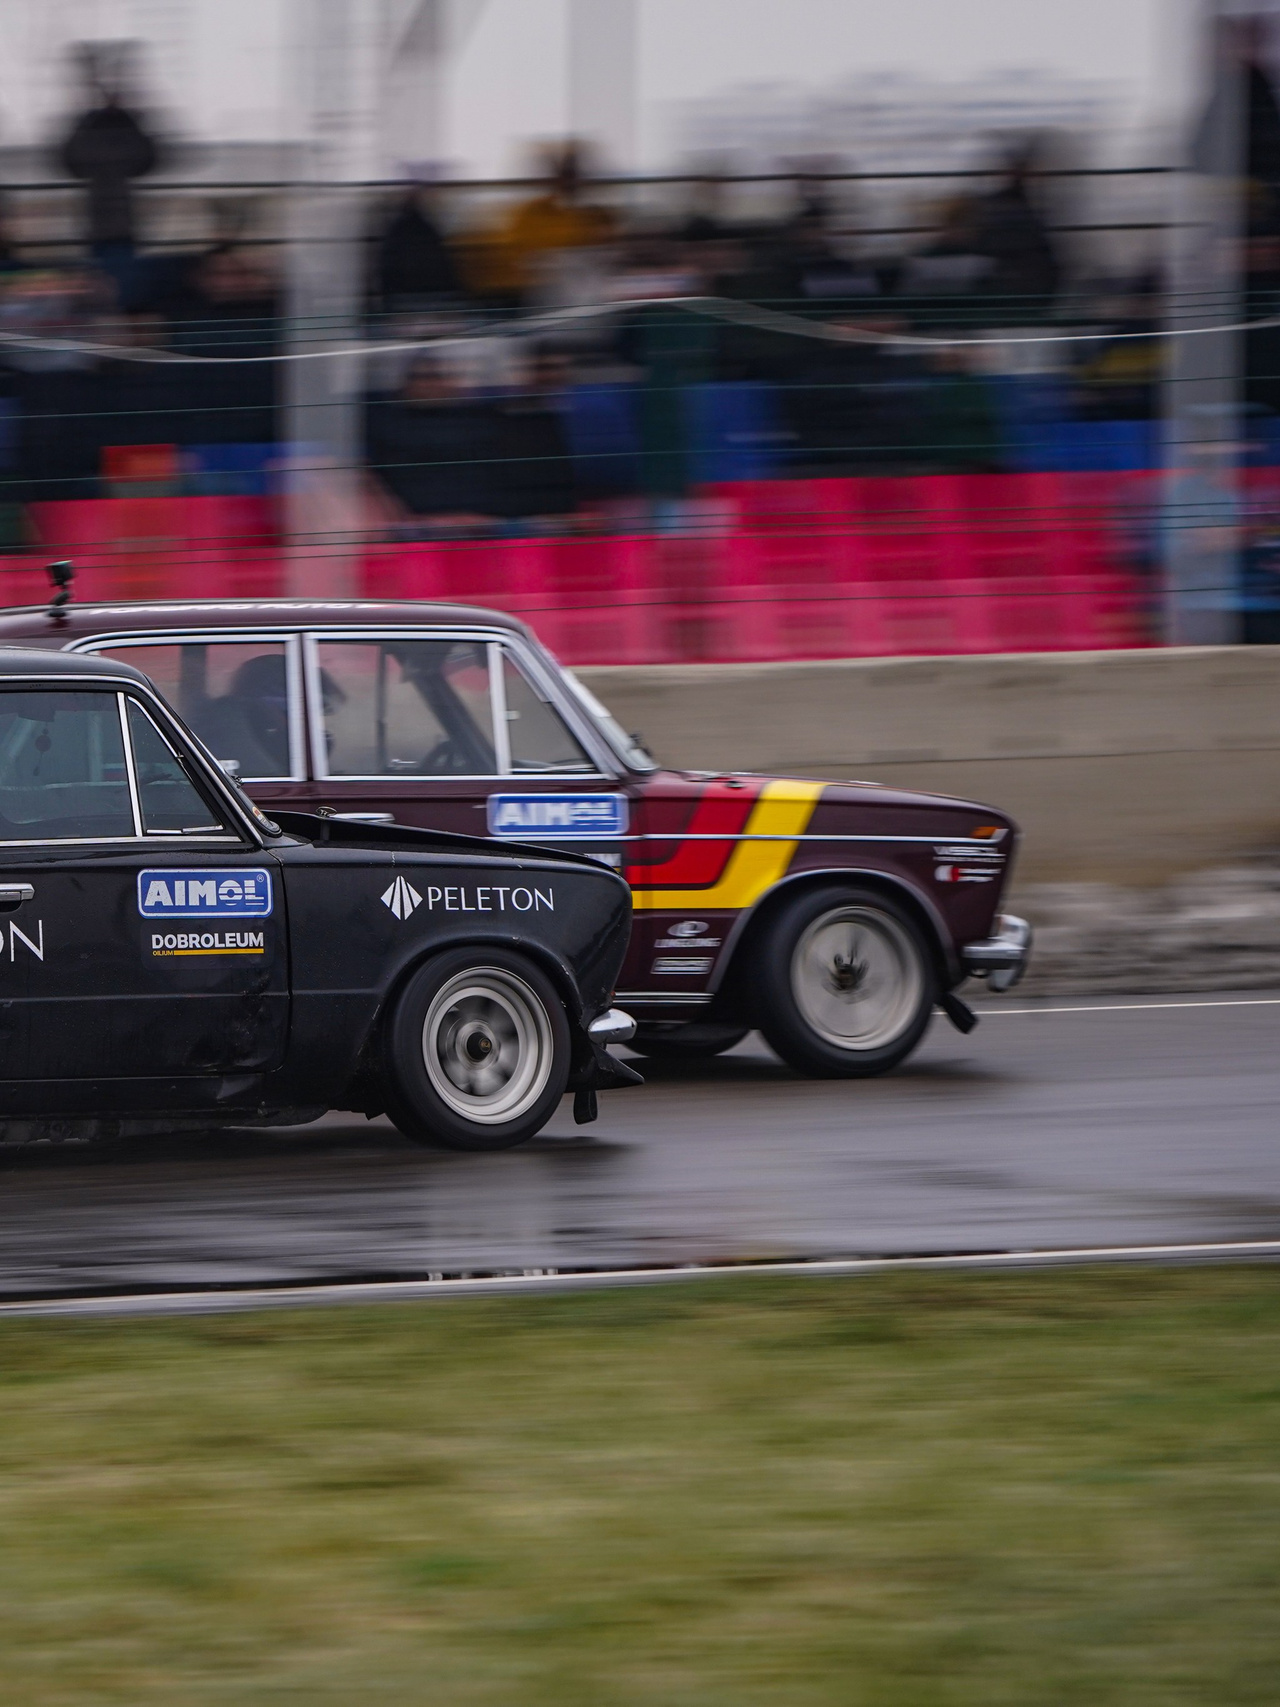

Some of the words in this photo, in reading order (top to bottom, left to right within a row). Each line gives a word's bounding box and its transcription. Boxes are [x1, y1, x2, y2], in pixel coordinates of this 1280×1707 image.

[144, 880, 265, 906] AIMOL
[427, 886, 555, 912] PELETON
[151, 932, 264, 949] DOBROLEUM
